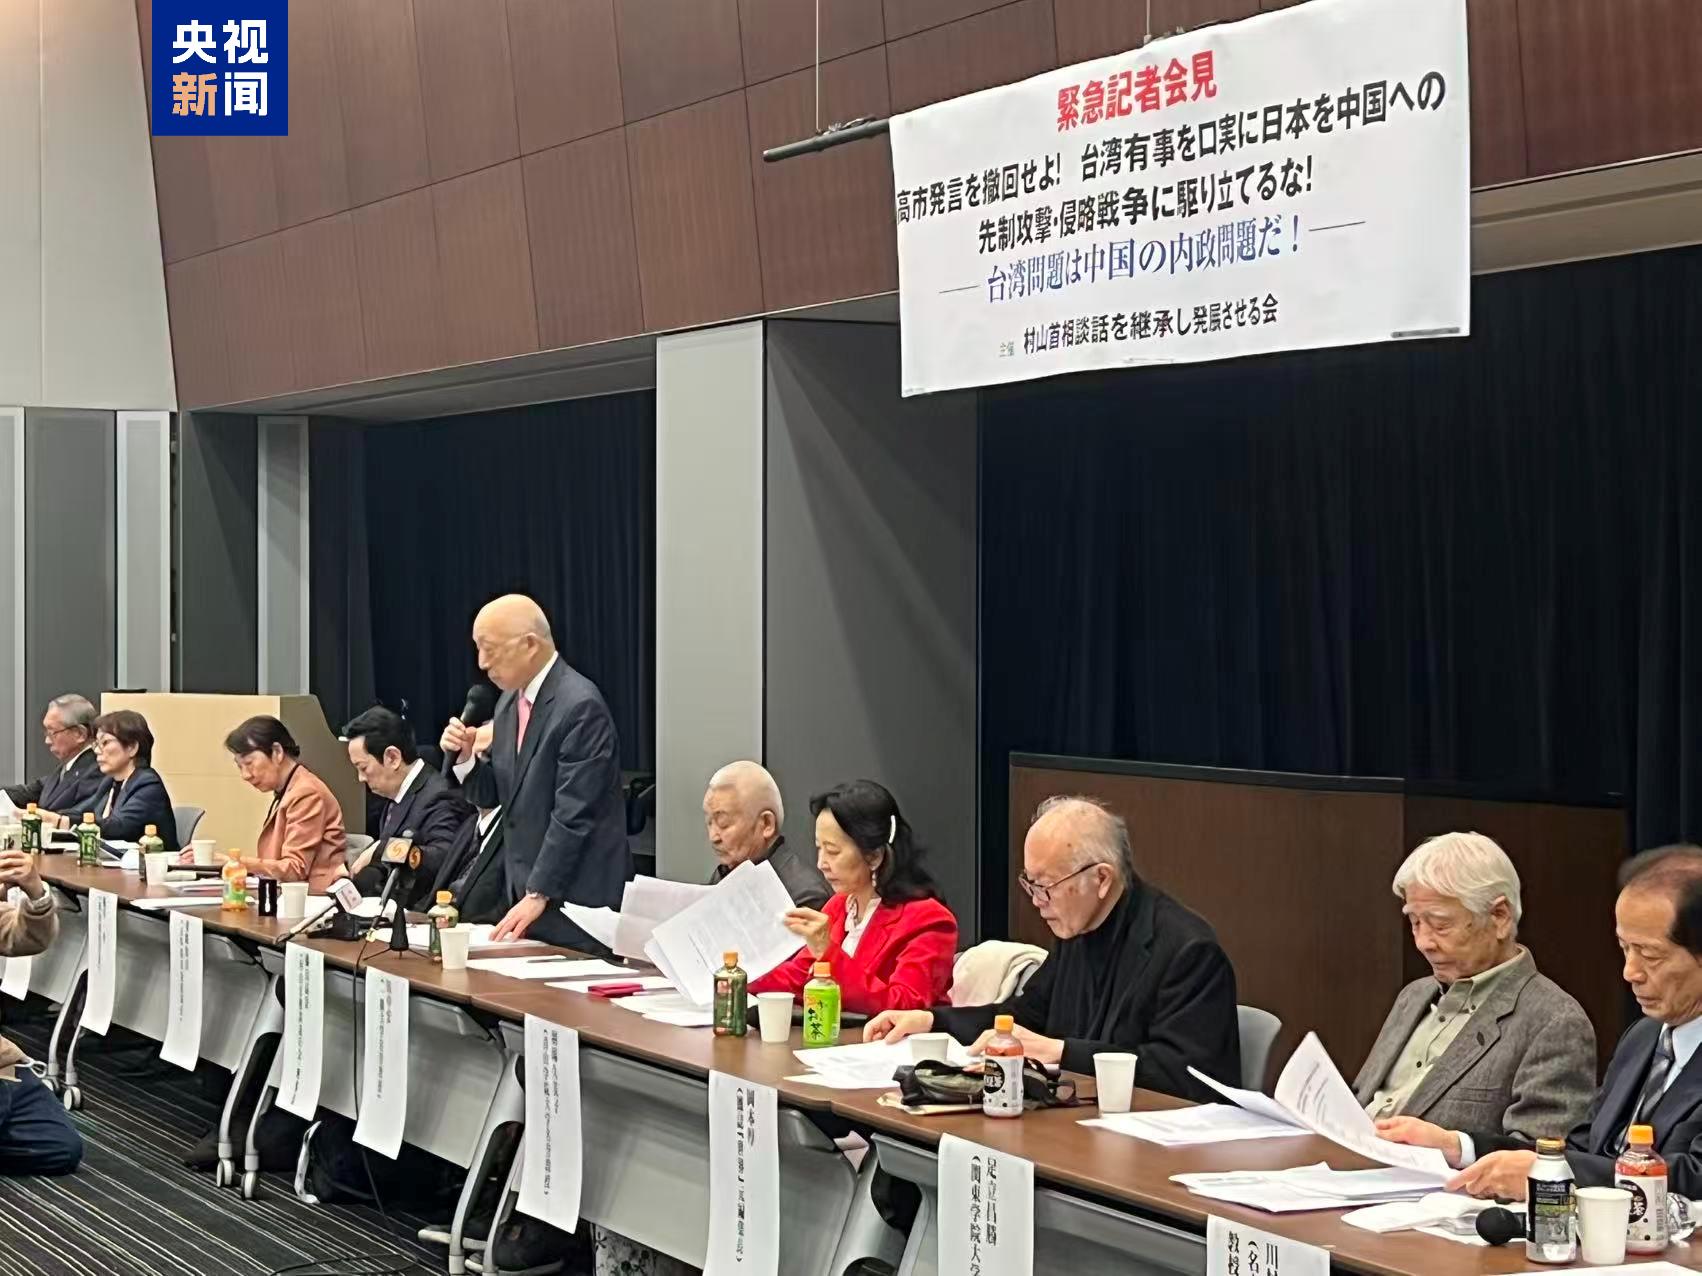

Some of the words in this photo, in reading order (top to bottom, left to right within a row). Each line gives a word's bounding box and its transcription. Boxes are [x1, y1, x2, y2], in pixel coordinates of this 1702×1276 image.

[1056, 50, 1218, 133] 緊急記者会見
[1080, 70, 1446, 182] 台湾有事を口実に日本を中国への
[1023, 292, 1279, 356] 村山首相談話を継承し発展させる会
